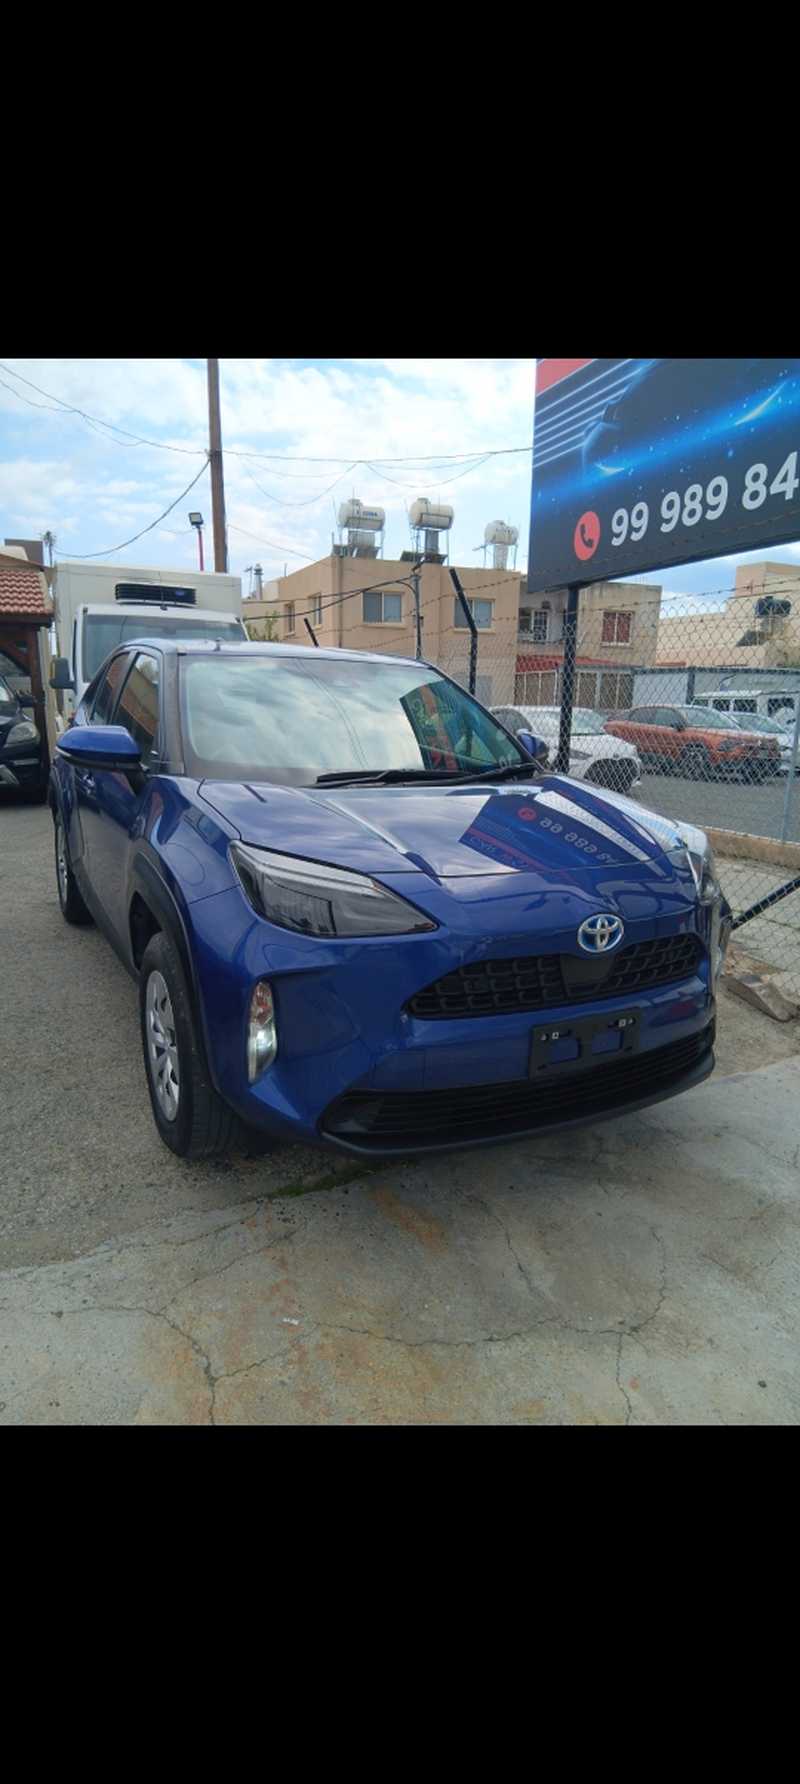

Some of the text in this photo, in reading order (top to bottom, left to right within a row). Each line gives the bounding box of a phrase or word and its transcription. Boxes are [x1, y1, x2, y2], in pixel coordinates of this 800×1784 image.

[611, 451, 800, 546] 99 989 84
